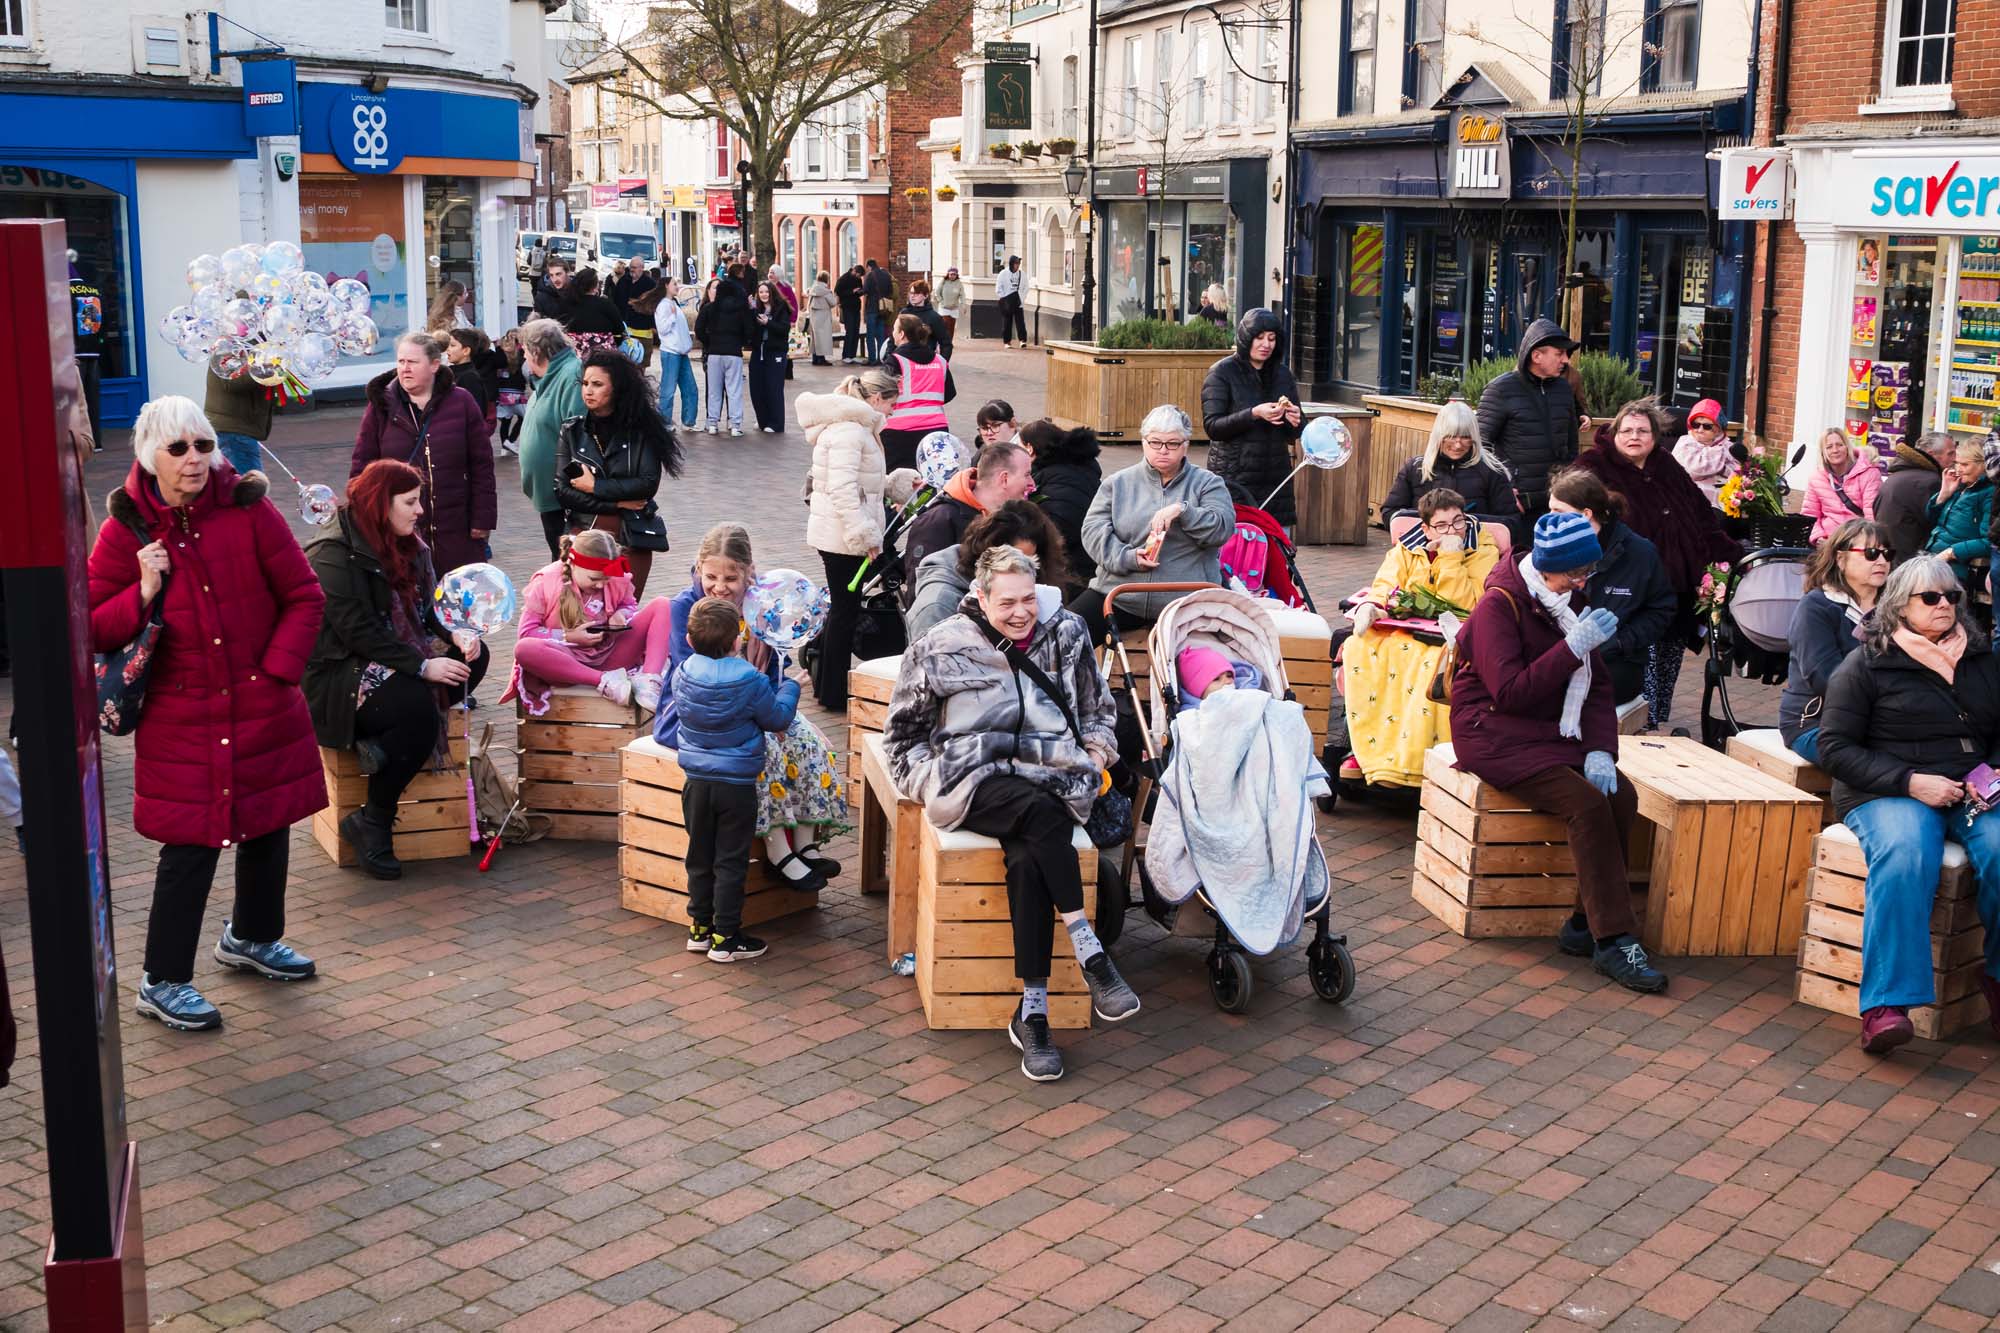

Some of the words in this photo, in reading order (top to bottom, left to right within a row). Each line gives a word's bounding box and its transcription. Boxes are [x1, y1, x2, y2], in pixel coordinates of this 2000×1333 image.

[250, 93, 284, 105] BETFRED
[352, 93, 386, 103] Lincolnshire
[1457, 113, 1502, 143] William
[1456, 148, 1500, 188] HILL
[1871, 160, 2000, 217] saver
[318, 206, 349, 216] money
[1733, 196, 1778, 210] savers
[1684, 259, 1709, 279] FRE
[1682, 278, 1708, 304] BE
